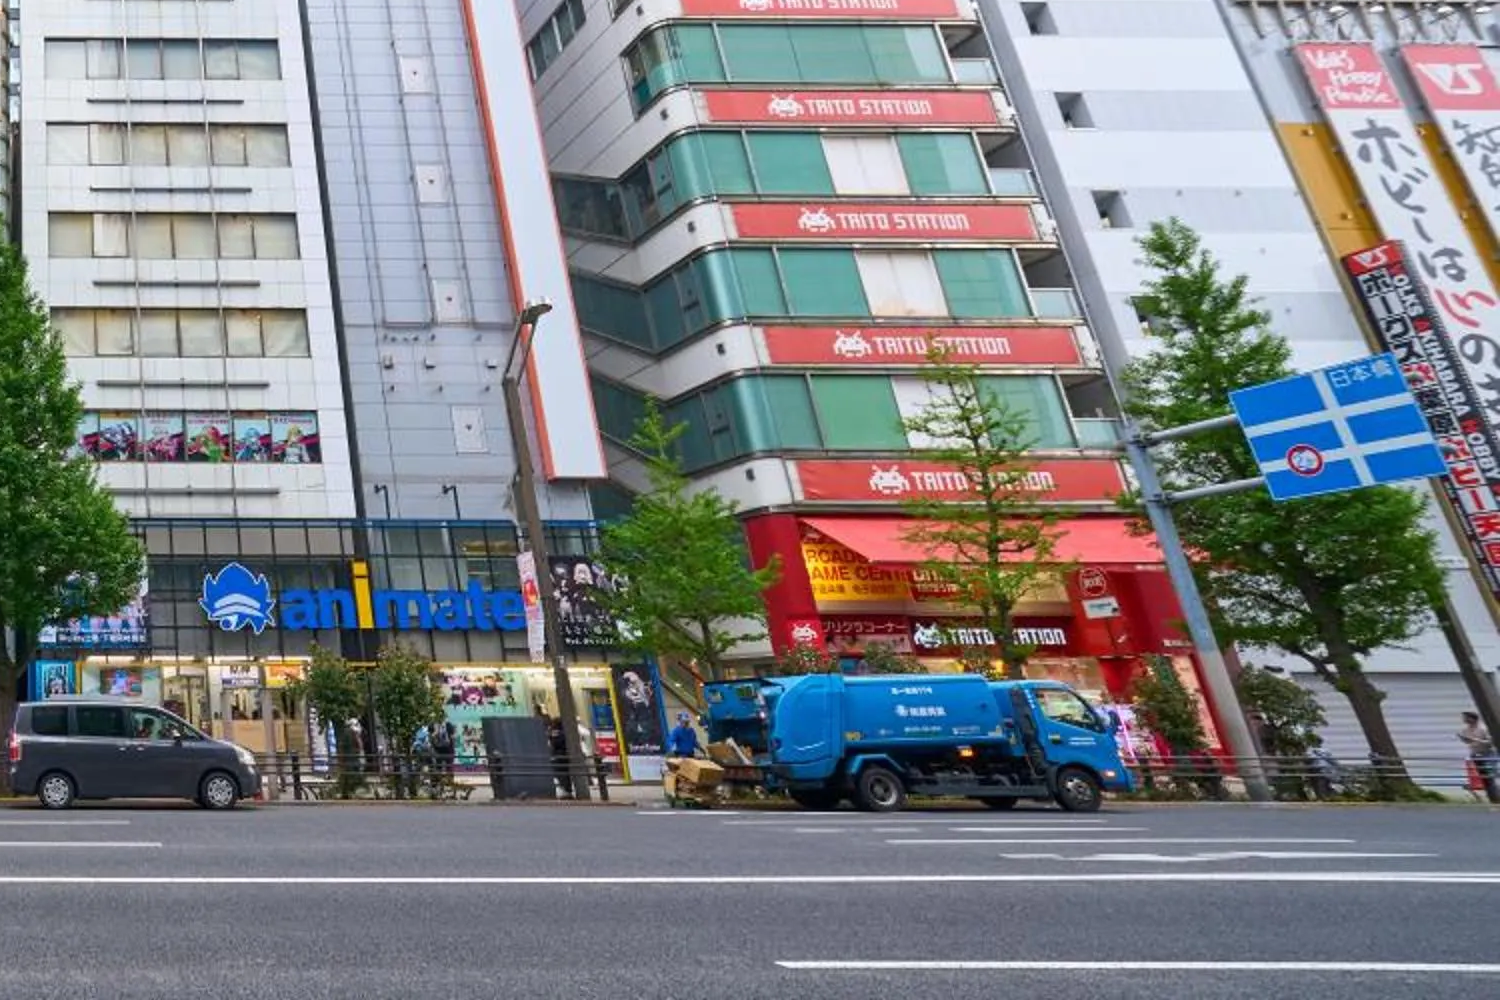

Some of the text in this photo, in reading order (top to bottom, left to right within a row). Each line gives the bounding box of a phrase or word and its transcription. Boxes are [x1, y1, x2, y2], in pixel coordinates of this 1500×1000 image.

[804, 98, 932, 115] TAITO STATION
[836, 213, 970, 230] TAITO STATION
[872, 336, 1012, 354] TAITO STATION
[911, 471, 969, 491] TAITO
[281, 560, 527, 630] animate
[946, 628, 995, 645] TAITO
